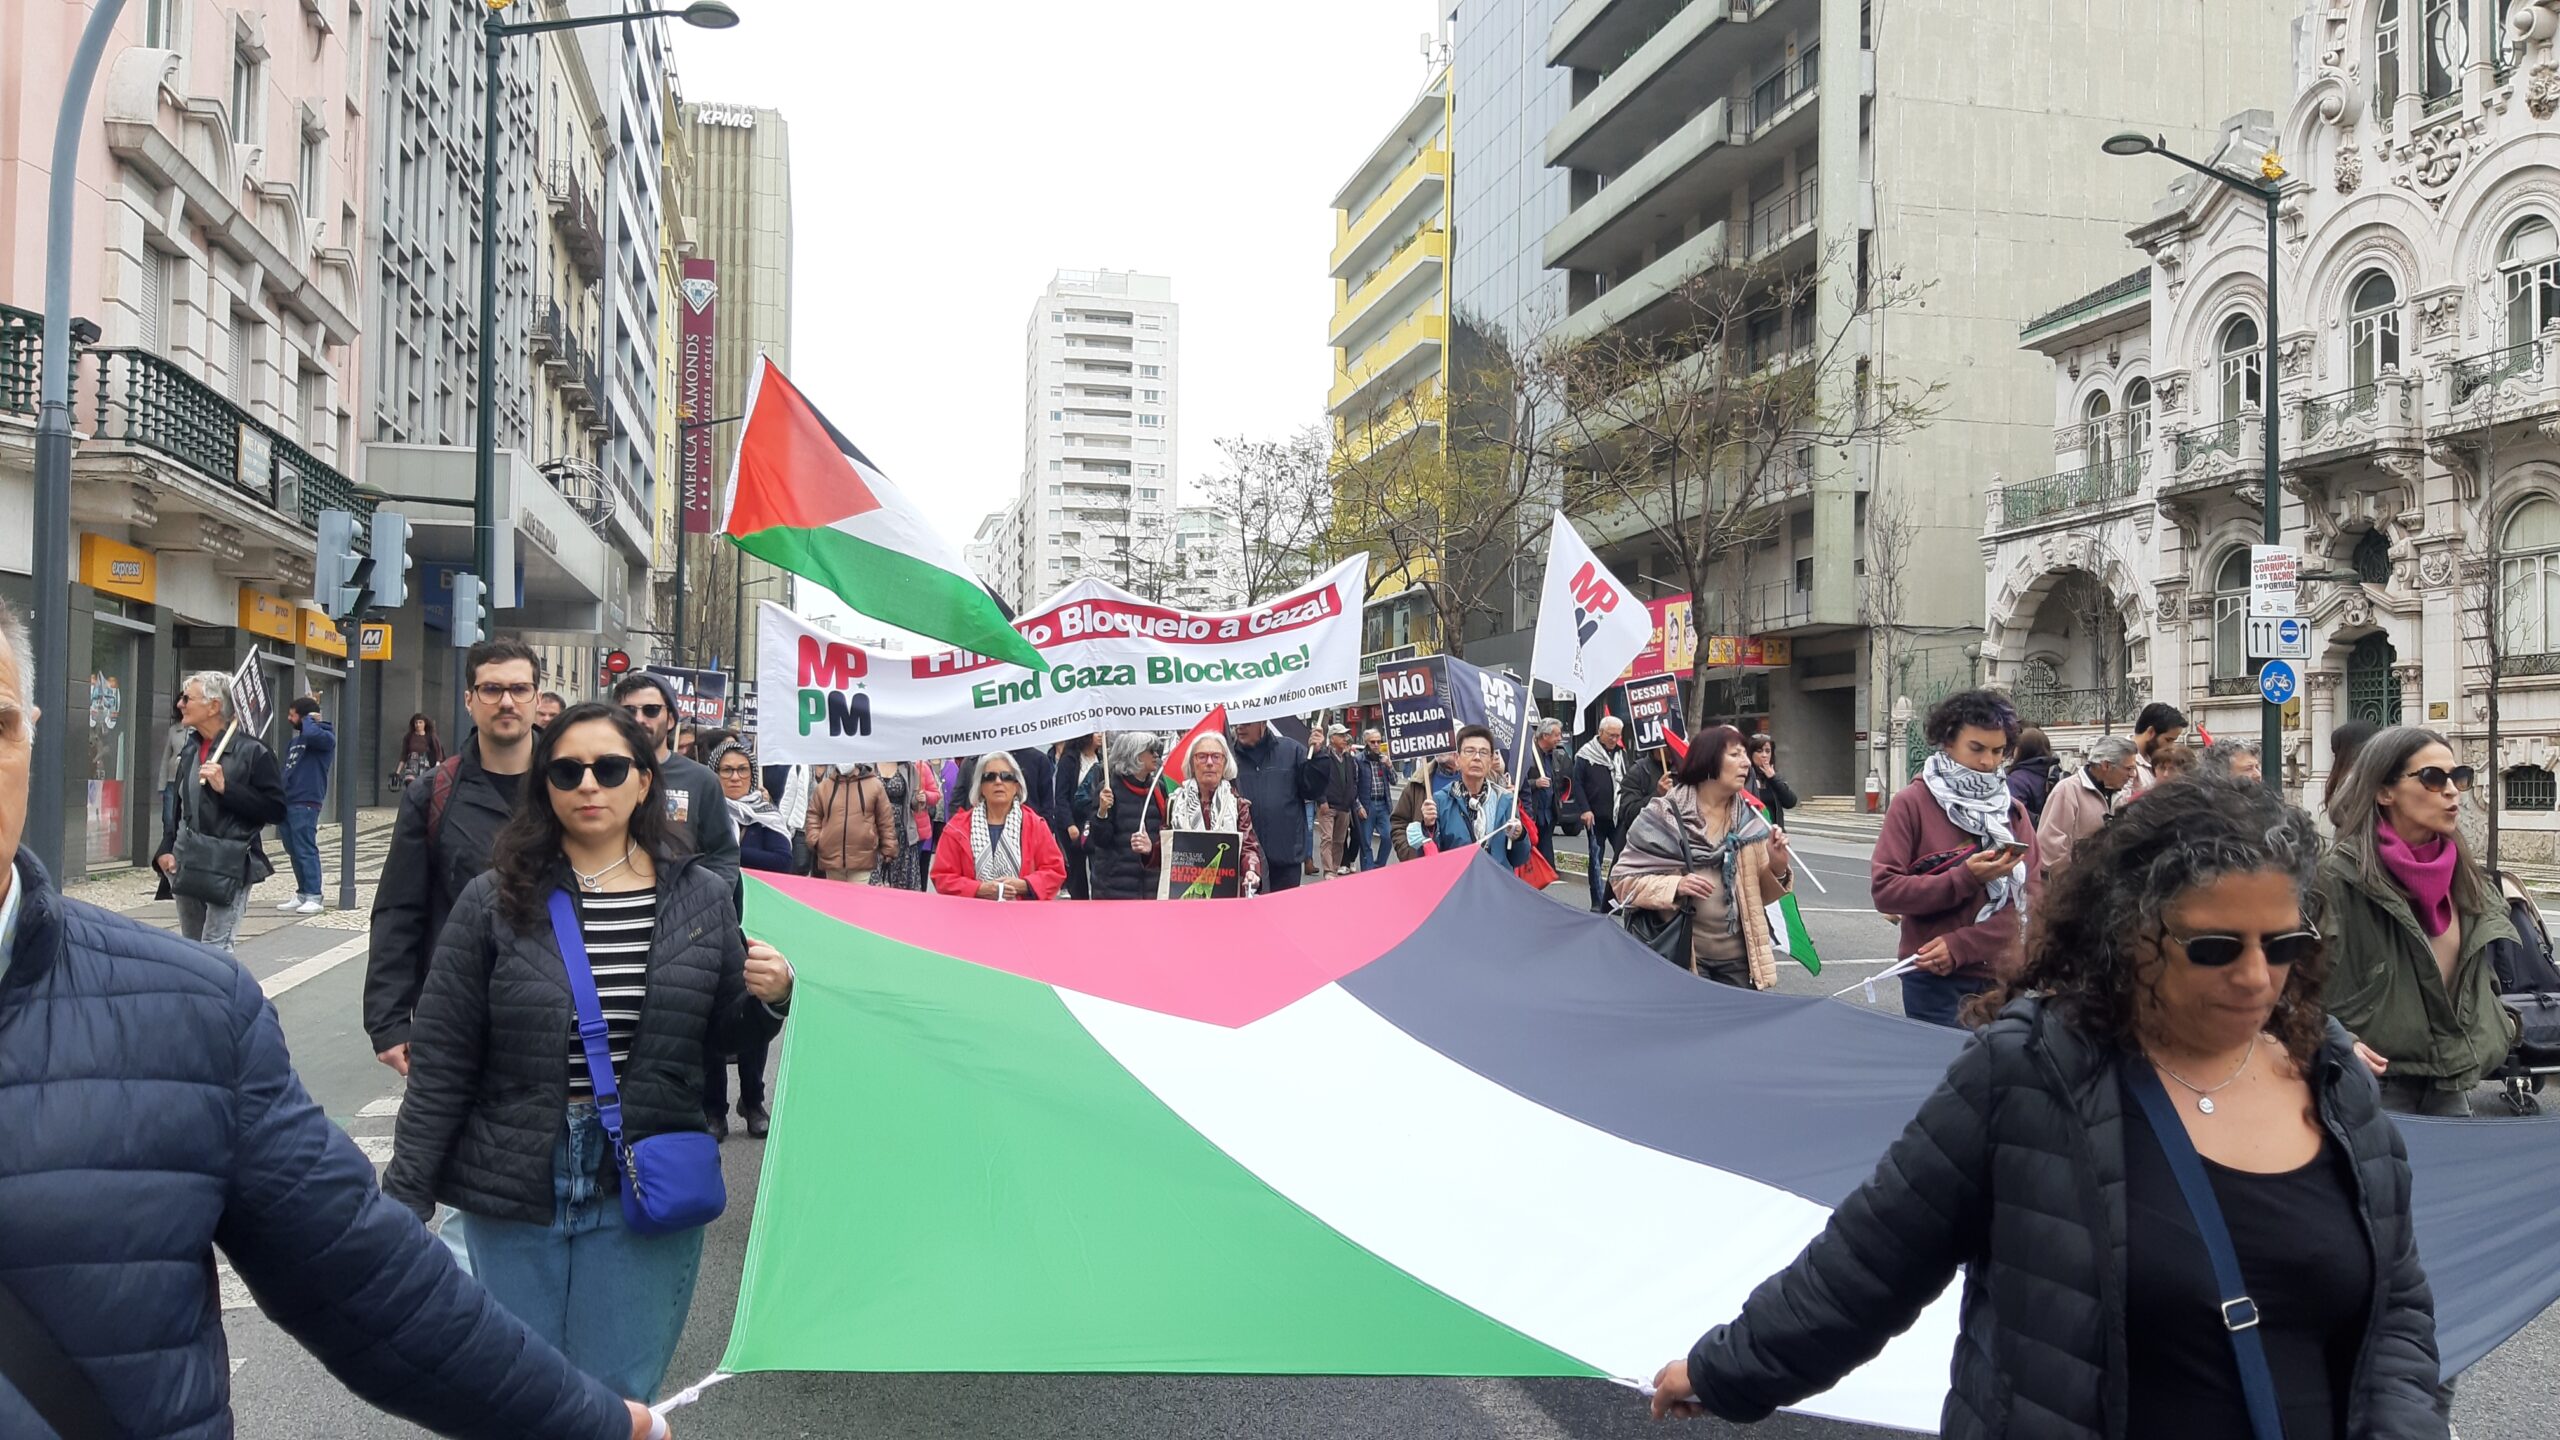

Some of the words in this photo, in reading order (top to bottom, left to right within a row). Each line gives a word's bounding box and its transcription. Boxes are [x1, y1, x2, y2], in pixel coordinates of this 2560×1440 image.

[697, 109, 753, 128] KPMG
[704, 335, 712, 379] HOTELS
[684, 434, 697, 511] AMERICA
[2253, 561, 2295, 574] CORRUPÇÃO
[2266, 554, 2287, 562] ACABAR
[111, 560, 140, 580] express
[2268, 571, 2295, 582] TACHOS
[1569, 561, 1620, 614] MP
[2264, 581, 2295, 591] PORTUGAL
[1058, 604, 1211, 641] Bloqueio
[1218, 618, 1241, 638] a
[1248, 589, 1331, 635] Gaza!
[797, 634, 868, 690] MP
[249, 656, 266, 713] PALESTINA
[972, 669, 1042, 709] End
[1050, 664, 1137, 693] Gaza
[1147, 644, 1311, 685] Blockade!
[1382, 670, 1425, 700] NÃO
[1631, 683, 1675, 701] CESSAR-
[677, 698, 719, 717] PAÇÃO!
[744, 696, 757, 709] NÃ
[1633, 701, 1662, 717] FOGO
[797, 689, 872, 737] PM
[922, 728, 997, 746] MOVIMENTO
[1000, 721, 1038, 738] PELOS
[1040, 711, 1087, 730] DIREITOS
[1088, 707, 1105, 718] DO
[1105, 706, 1136, 717] POVO
[1139, 703, 1202, 717] PALESTINO
[1204, 702, 1212, 713] E
[1242, 697, 1262, 709] PAZ
[1263, 695, 1278, 706] NO
[1278, 688, 1307, 704] MÉDIO
[1307, 680, 1349, 697] ORIENTE
[1388, 707, 1446, 727] ESCALADA
[1391, 727, 1402, 738] DE
[1391, 732, 1450, 755] GUERRA!
[1171, 866, 1236, 877] AUTOMATING
[1171, 873, 1222, 885] GENOCIDE
